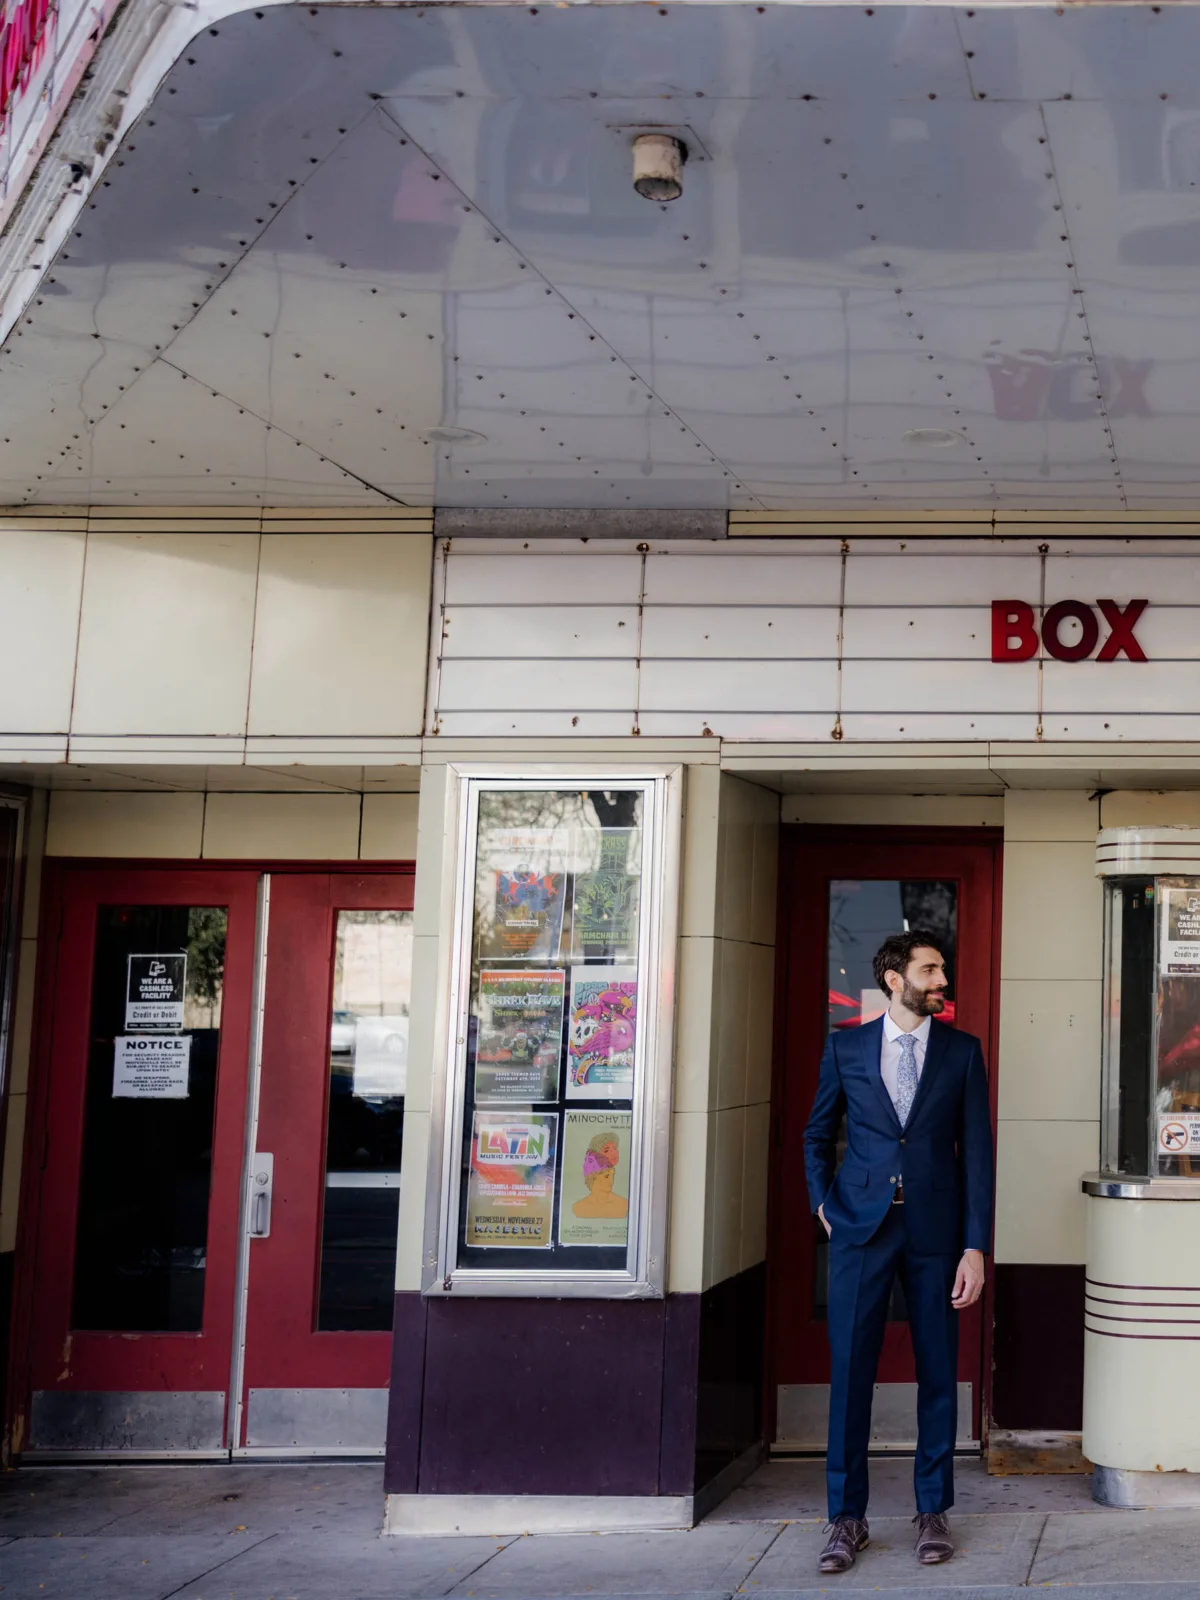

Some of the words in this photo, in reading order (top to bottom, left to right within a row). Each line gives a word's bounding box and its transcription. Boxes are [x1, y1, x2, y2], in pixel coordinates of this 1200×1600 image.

[991, 599, 1148, 663] BOX
[126, 1041, 183, 1049] NOTICE
[481, 1131, 544, 1156] LATIN
[475, 1216, 506, 1224] WEDNESDAY,
[474, 1225, 542, 1234] MAJESTIC
